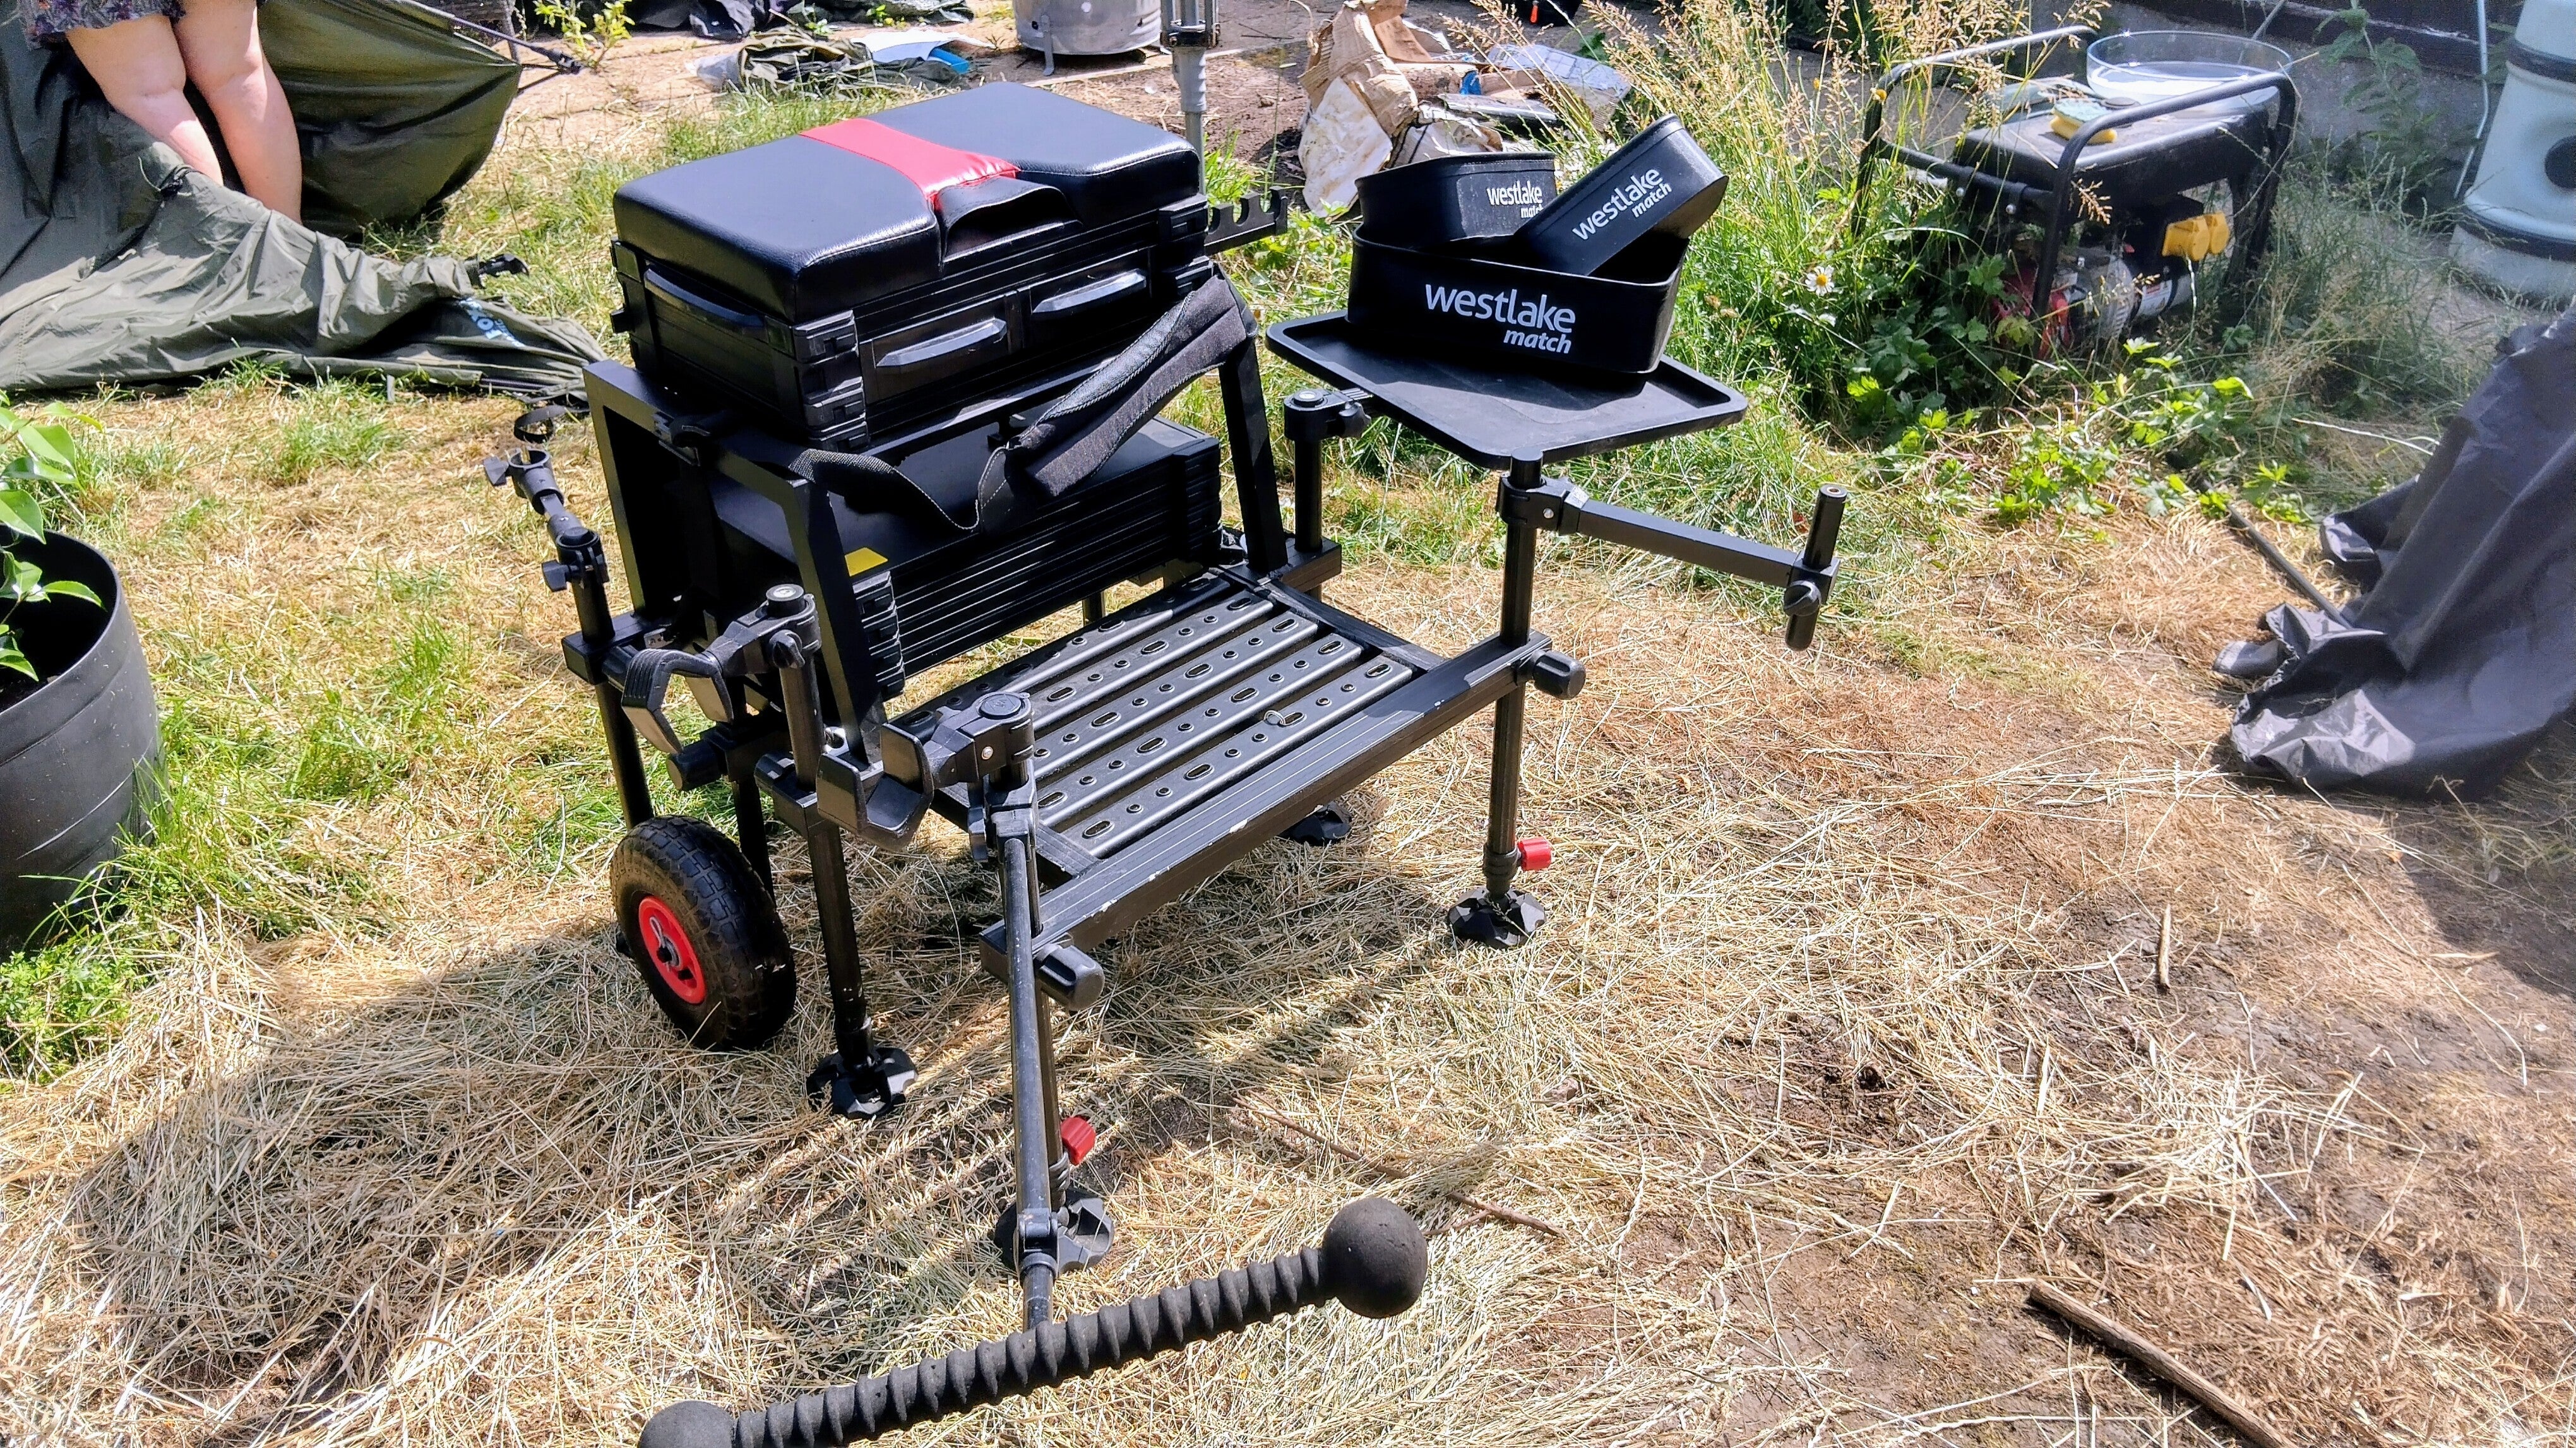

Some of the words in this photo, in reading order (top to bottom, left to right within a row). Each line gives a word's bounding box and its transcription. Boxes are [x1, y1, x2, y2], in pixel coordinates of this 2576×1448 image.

[1486, 180, 1543, 205] westlake
[1572, 169, 1663, 240] westlake
[1631, 183, 1672, 218] match
[1425, 284, 1576, 333] westlake
[1503, 329, 1572, 353] match
